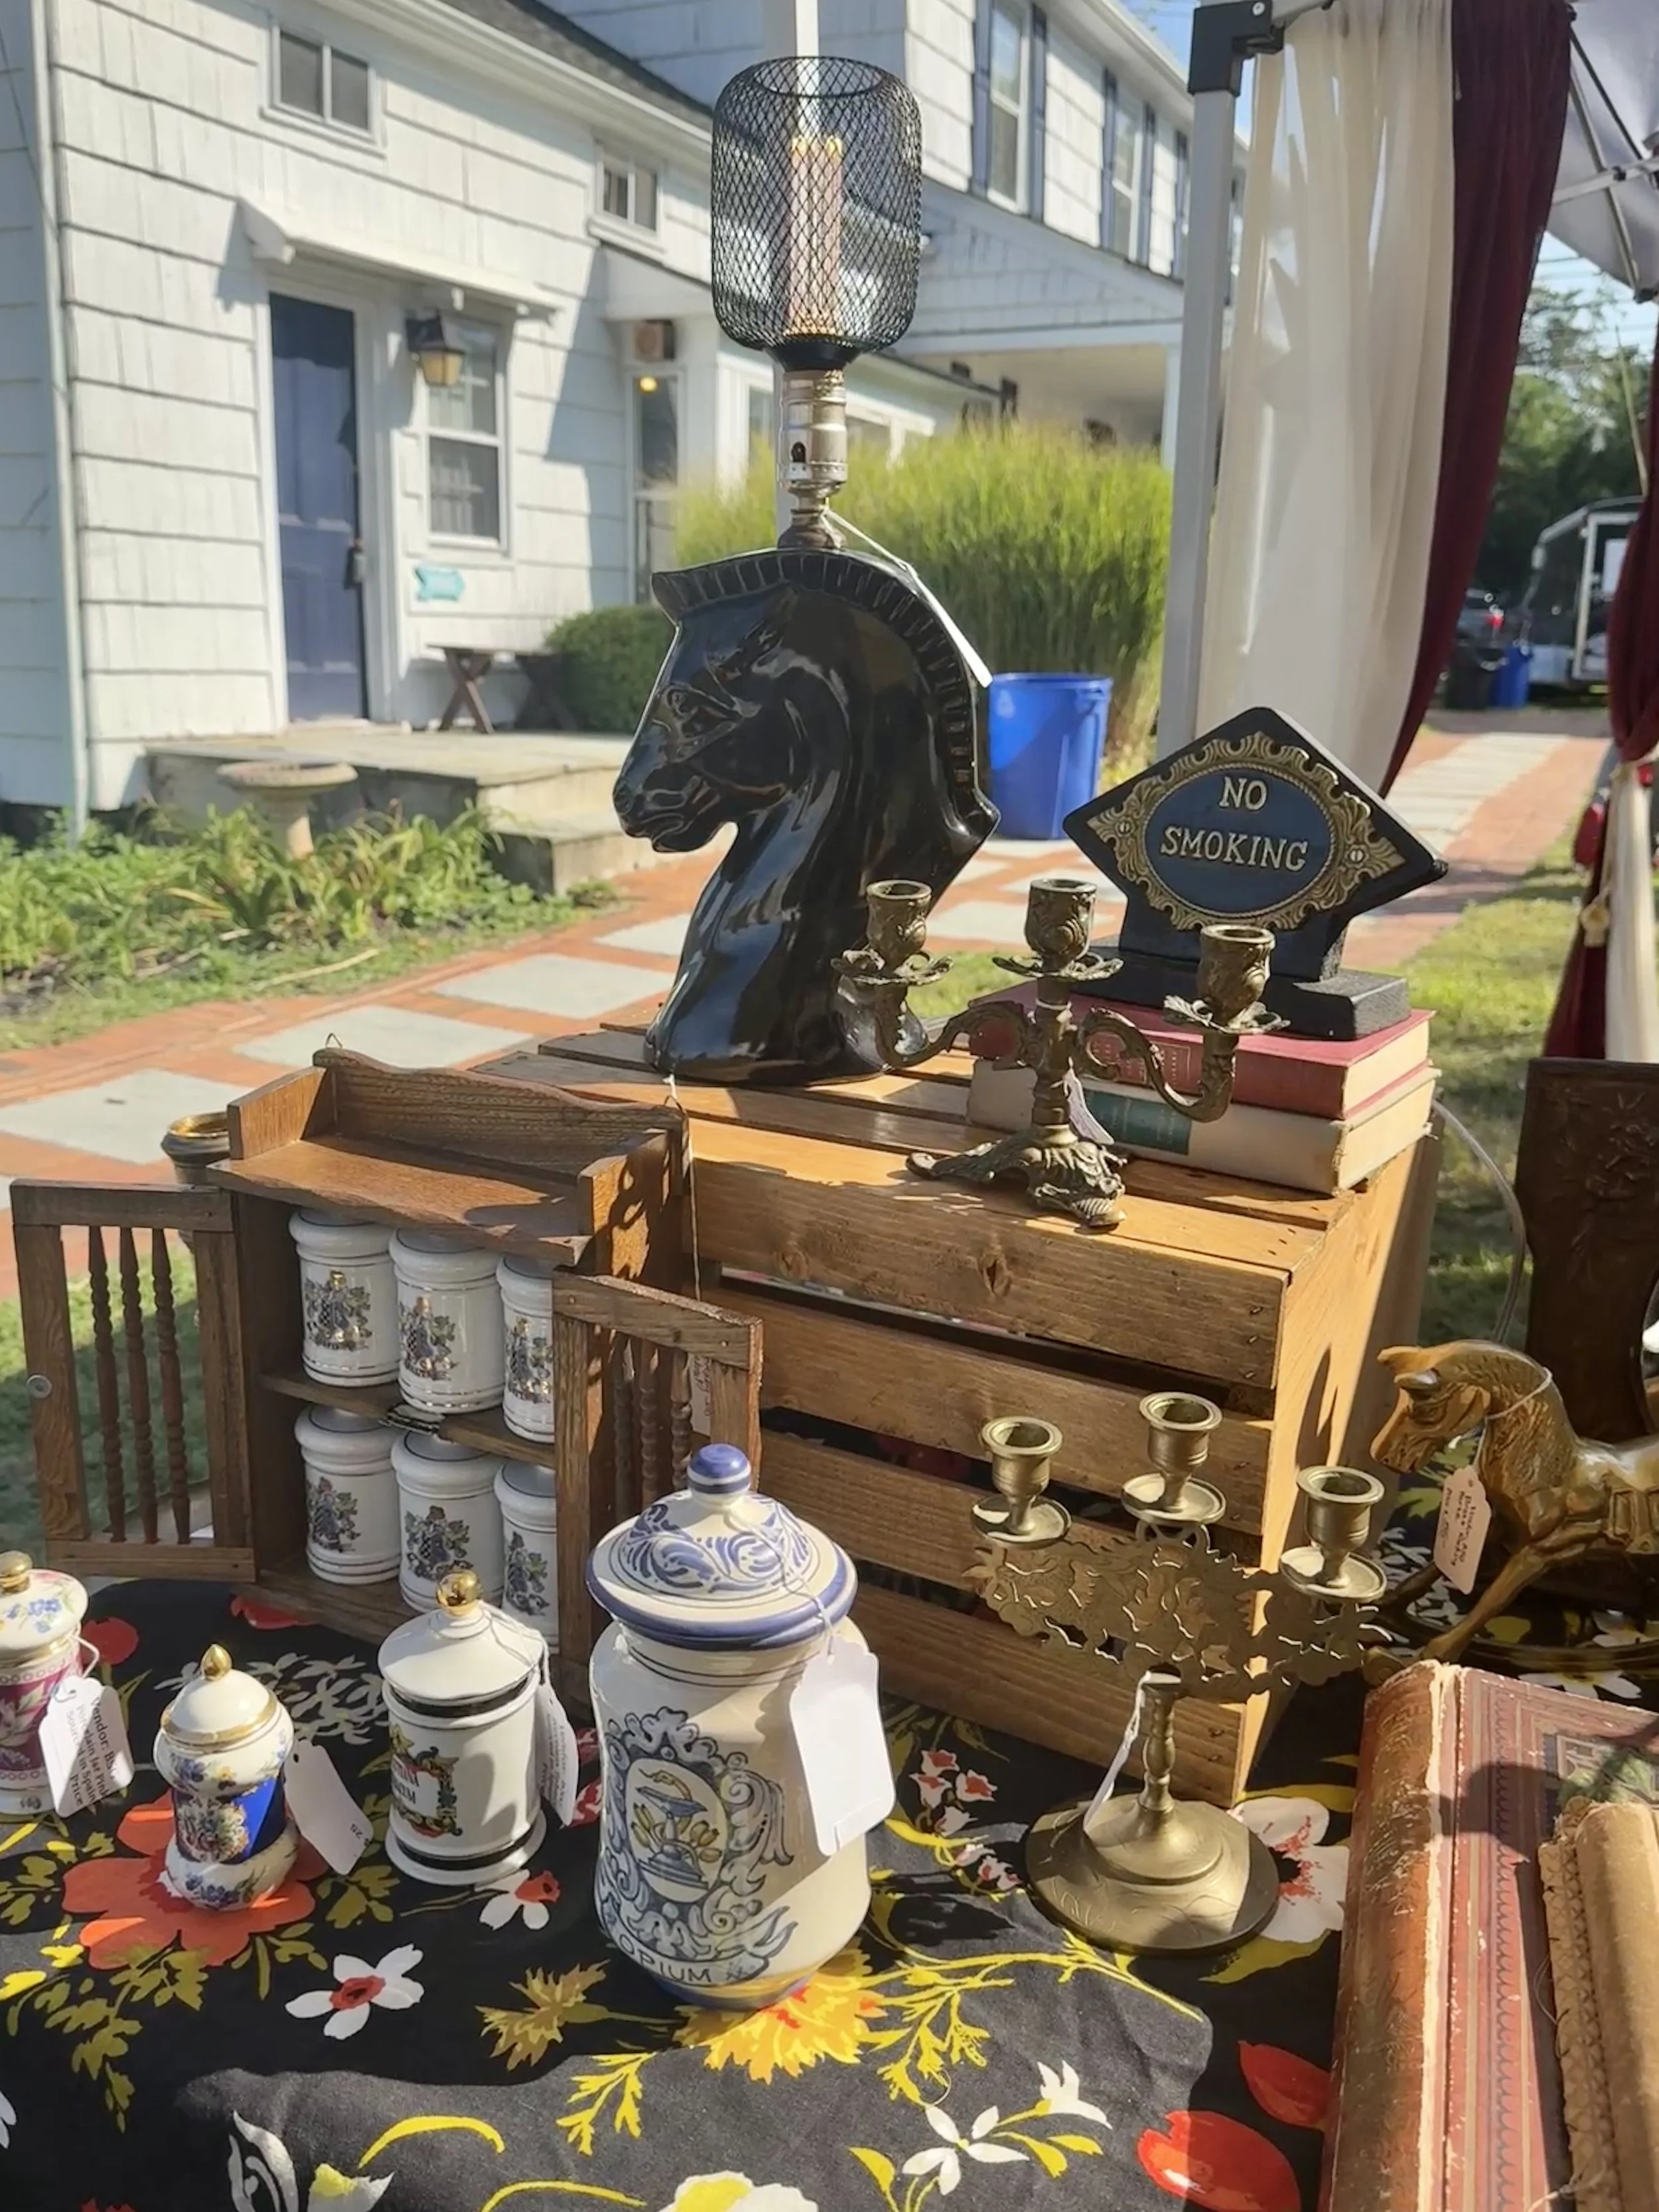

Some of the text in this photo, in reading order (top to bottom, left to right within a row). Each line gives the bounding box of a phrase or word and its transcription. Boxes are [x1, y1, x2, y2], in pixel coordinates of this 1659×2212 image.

[1219, 776, 1267, 810] NO
[1161, 826, 1309, 871] SMOKING
[618, 1933, 712, 1983] OPIUM
